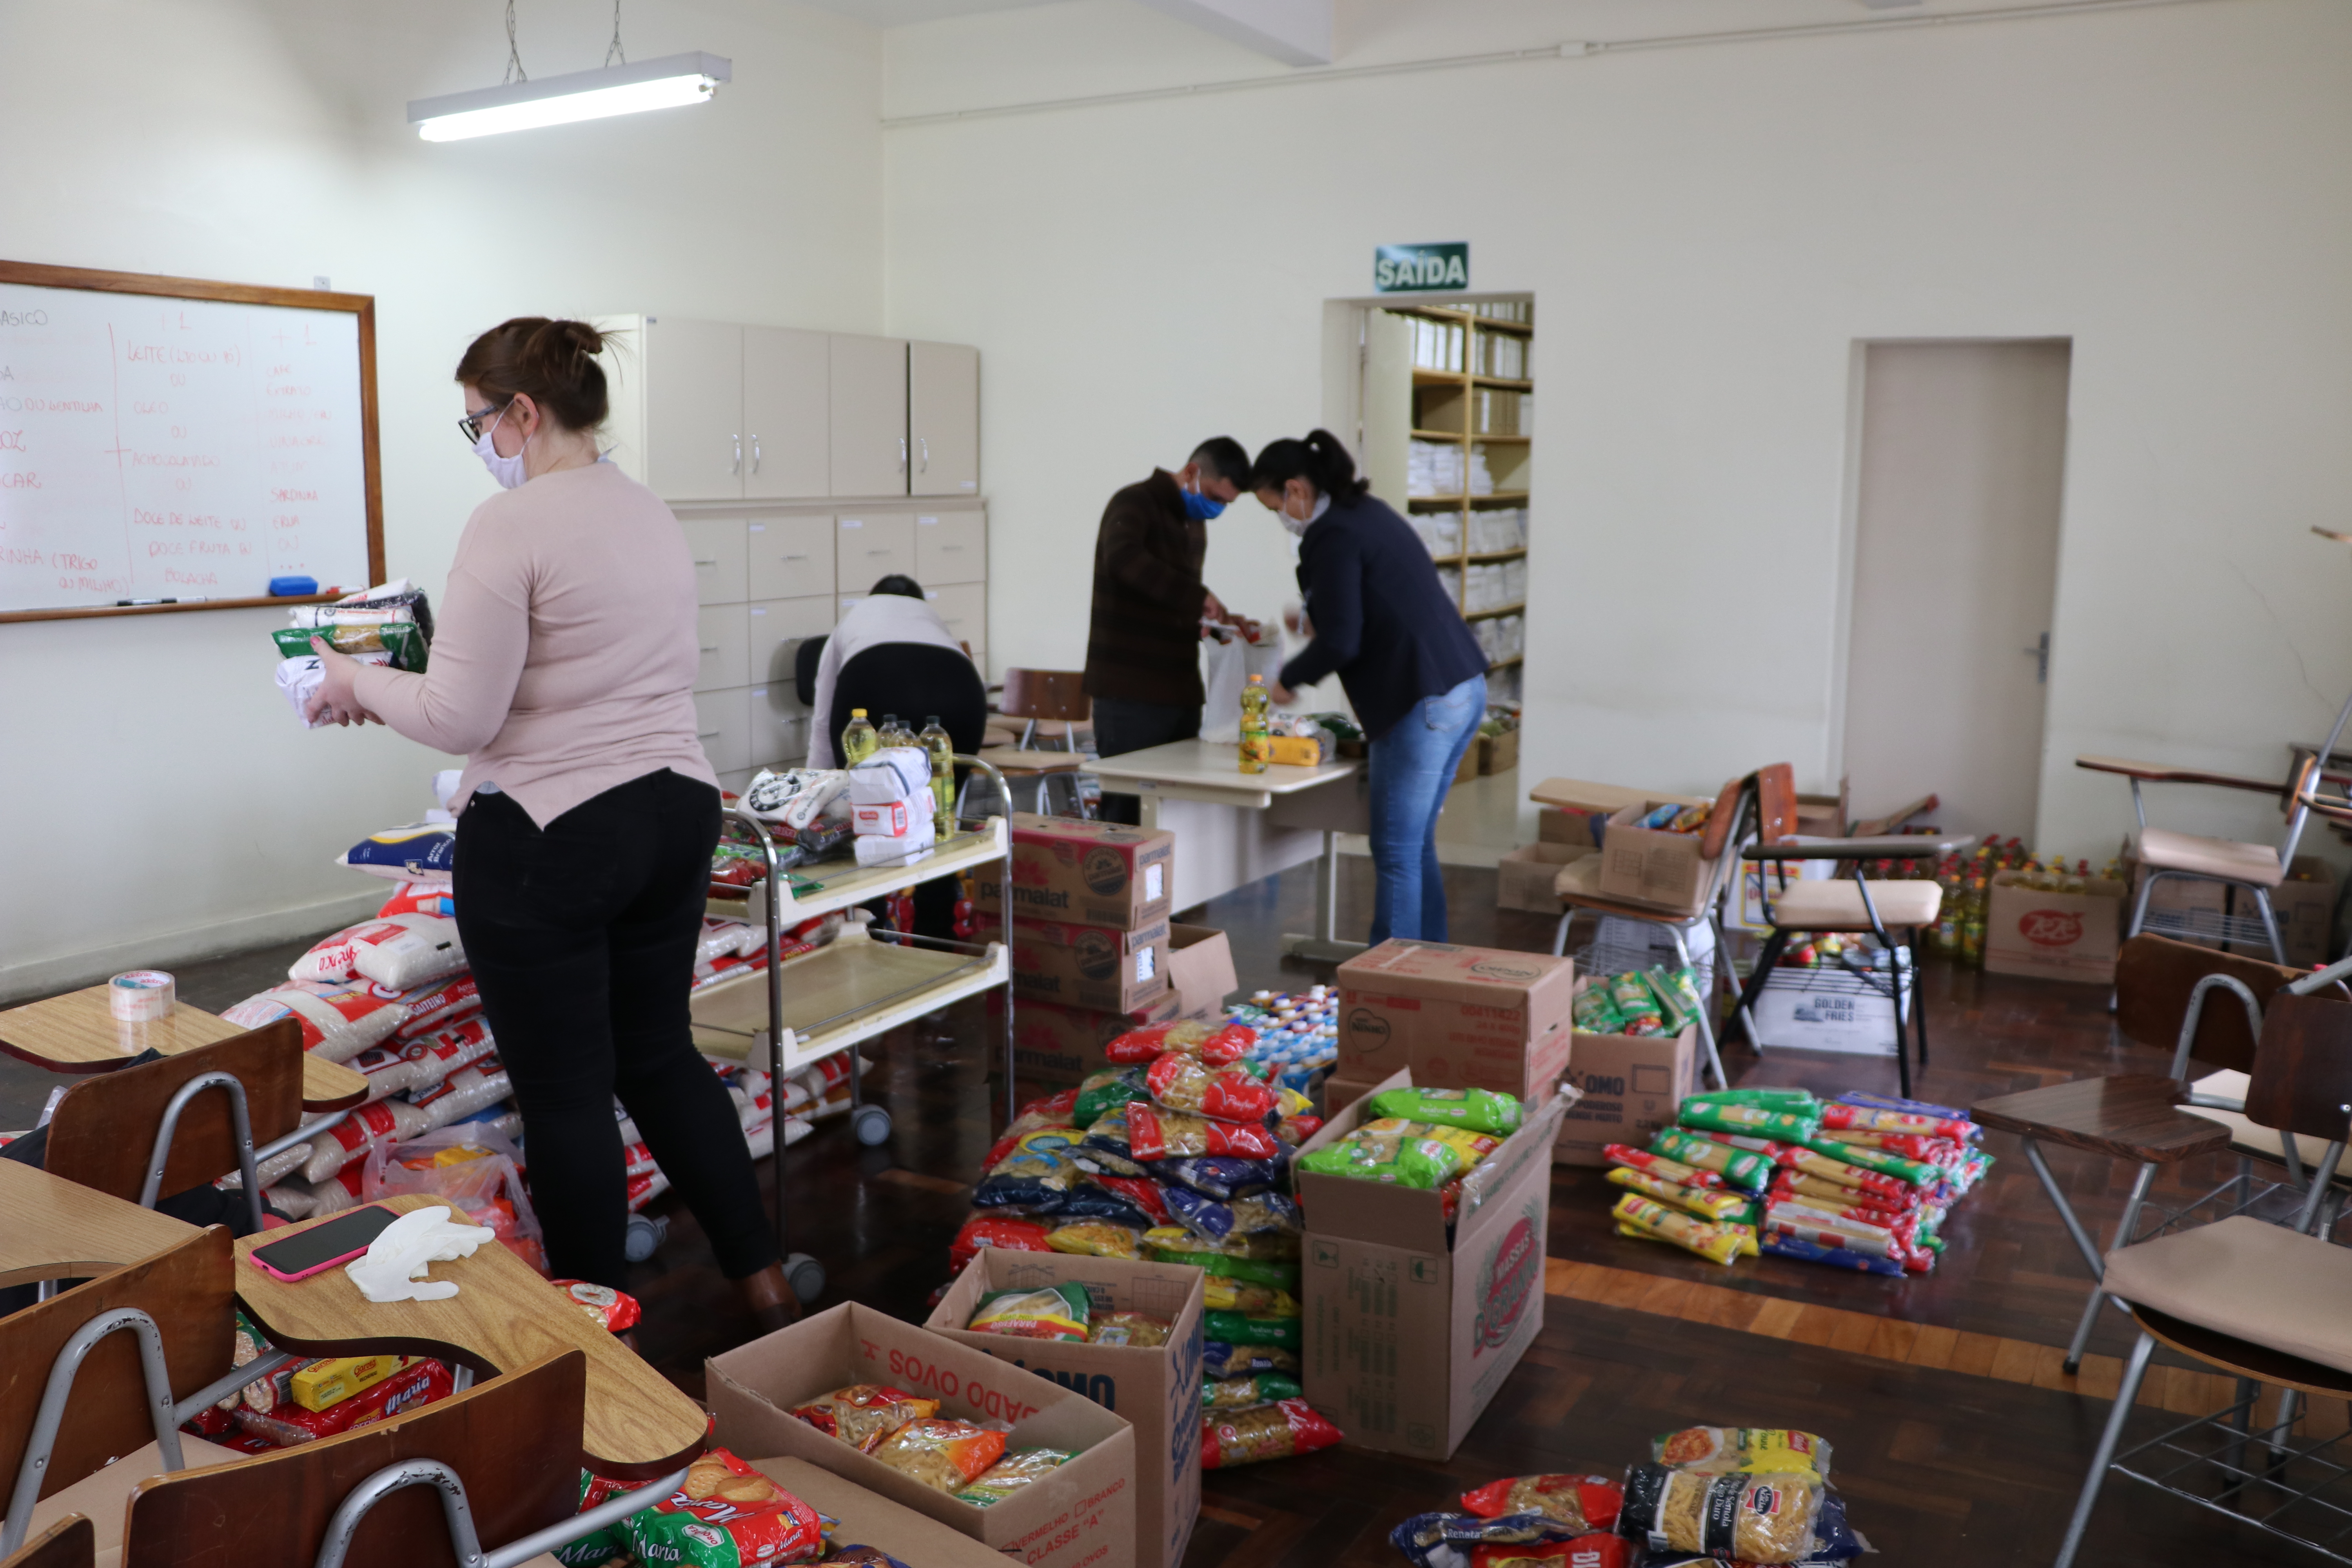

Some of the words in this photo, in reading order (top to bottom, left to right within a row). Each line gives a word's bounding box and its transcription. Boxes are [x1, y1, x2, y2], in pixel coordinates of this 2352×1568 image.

[1377, 250, 1466, 287] SAÍDA
[0, 308, 47, 326] ASICO
[128, 339, 167, 365] LEITE
[170, 373, 185, 387] OU
[25, 397, 45, 411] OU
[49, 399, 103, 413] LENTILHA
[0, 429, 26, 452] OZ
[171, 425, 187, 439] OU
[132, 452, 220, 467] ACHOCOLATADO
[0, 472, 42, 488] CAR
[175, 476, 192, 491] OU
[269, 487, 318, 503] SARDINHA
[134, 508, 165, 525] DOCE
[169, 512, 183, 525] DE
[189, 513, 222, 529] LEITE
[230, 518, 246, 531] OU
[149, 540, 183, 557] DOCE
[190, 539, 230, 555] FRUTA
[165, 567, 218, 585] BOLACHA
[427, 842, 441, 862] Arroz
[433, 838, 451, 862] Branco
[1139, 844, 1171, 865] parmalat
[980, 881, 1069, 909] pamalat
[1131, 922, 1167, 947] parmalat
[412, 993, 446, 1016] GAITEIRO
[1815, 998, 1855, 1010] GOLDEN
[1825, 1011, 1855, 1022] FRIES
[1586, 1074, 1624, 1096] OMO
[990, 1319, 1037, 1328] PARAFUSO
[354, 1359, 377, 1377] Garoto
[889, 1349, 959, 1397] OVOS
[385, 1376, 431, 1416] Maria
[1087, 1478, 1125, 1508] BRANCO
[670, 1492, 755, 1524] Mara
[1713, 1498, 1722, 1521] Duro
[1722, 1495, 1735, 1527] Sémola
[1014, 1512, 1069, 1550] VERMELHO
[1448, 1528, 1482, 1539] Renata
[632, 1529, 682, 1562] Maria
[1027, 1523, 1080, 1565] CLASSE
[1083, 1544, 1109, 1567] OVOS
